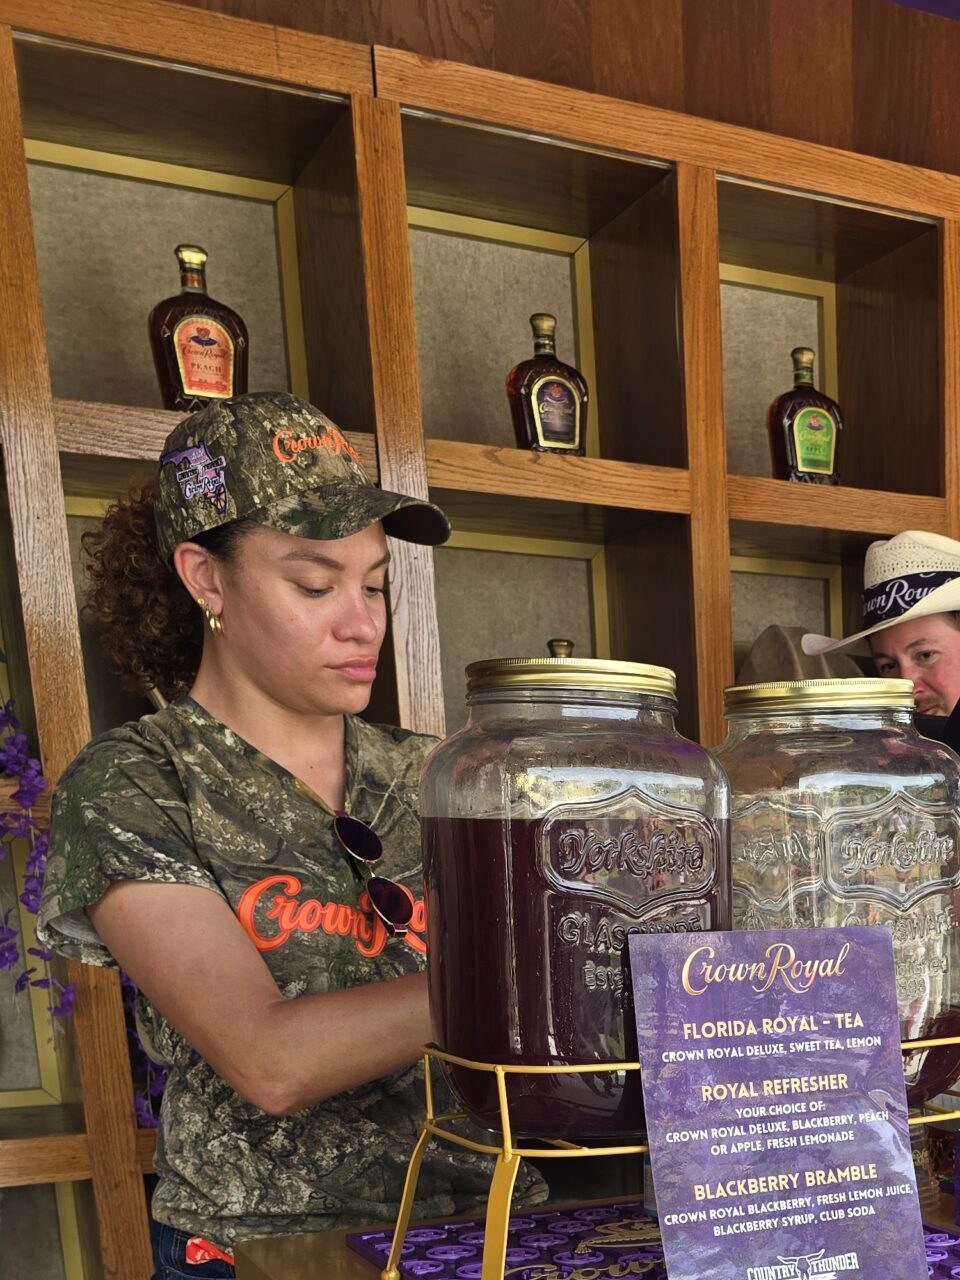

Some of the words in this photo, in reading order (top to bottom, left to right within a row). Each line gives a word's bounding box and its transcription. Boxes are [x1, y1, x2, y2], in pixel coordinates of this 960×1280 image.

[191, 362, 222, 373] PEACH
[273, 428, 334, 463] Crown
[558, 830, 702, 879] Yorkshire
[238, 875, 372, 951] Crown
[681, 946, 767, 996] Crown
[751, 943, 850, 994] Royal
[683, 1019, 757, 1040] FLORIDA
[762, 1015, 818, 1034] ROYAL
[835, 1012, 864, 1029] TEA
[662, 1049, 704, 1062] CROWN
[707, 1046, 744, 1059] ROYAL
[746, 1043, 787, 1055] DELUXE,
[789, 1041, 822, 1053] SWEET
[823, 1038, 845, 1050] TEA,
[847, 1036, 881, 1048] LEMON
[702, 1082, 758, 1101] ROYAL
[763, 1074, 848, 1096] REFRESHER
[736, 1106, 767, 1118] YOUR
[769, 1102, 807, 1115] CHOICE
[809, 1101, 826, 1111] OF:
[666, 1129, 708, 1143] CROWN
[711, 1126, 746, 1139] ROYAL
[749, 1121, 790, 1135] DELUXE,
[792, 1114, 857, 1130] BLACKBERRY,
[859, 1111, 889, 1123] PEACH
[711, 1144, 728, 1156] OR
[730, 1140, 765, 1154] APPLE,
[767, 1136, 797, 1149] FRESH
[800, 1131, 855, 1146] LEMONADE
[694, 1173, 800, 1201] BLACKBERRY
[805, 1163, 878, 1188] BRAMBLE
[664, 1210, 707, 1226] CROWN
[710, 1206, 745, 1220] ROYAL
[747, 1195, 816, 1215] BLACKBERRY,
[817, 1192, 846, 1206] FRESH
[848, 1187, 884, 1201] LEMON
[886, 1183, 914, 1196] JUICE,
[713, 1218, 778, 1237] BLACKBERRY
[782, 1213, 818, 1228] SYRUP,
[820, 1208, 845, 1222] CLUB
[847, 1205, 876, 1218] SODA
[811, 1252, 859, 1273] THUNDER
